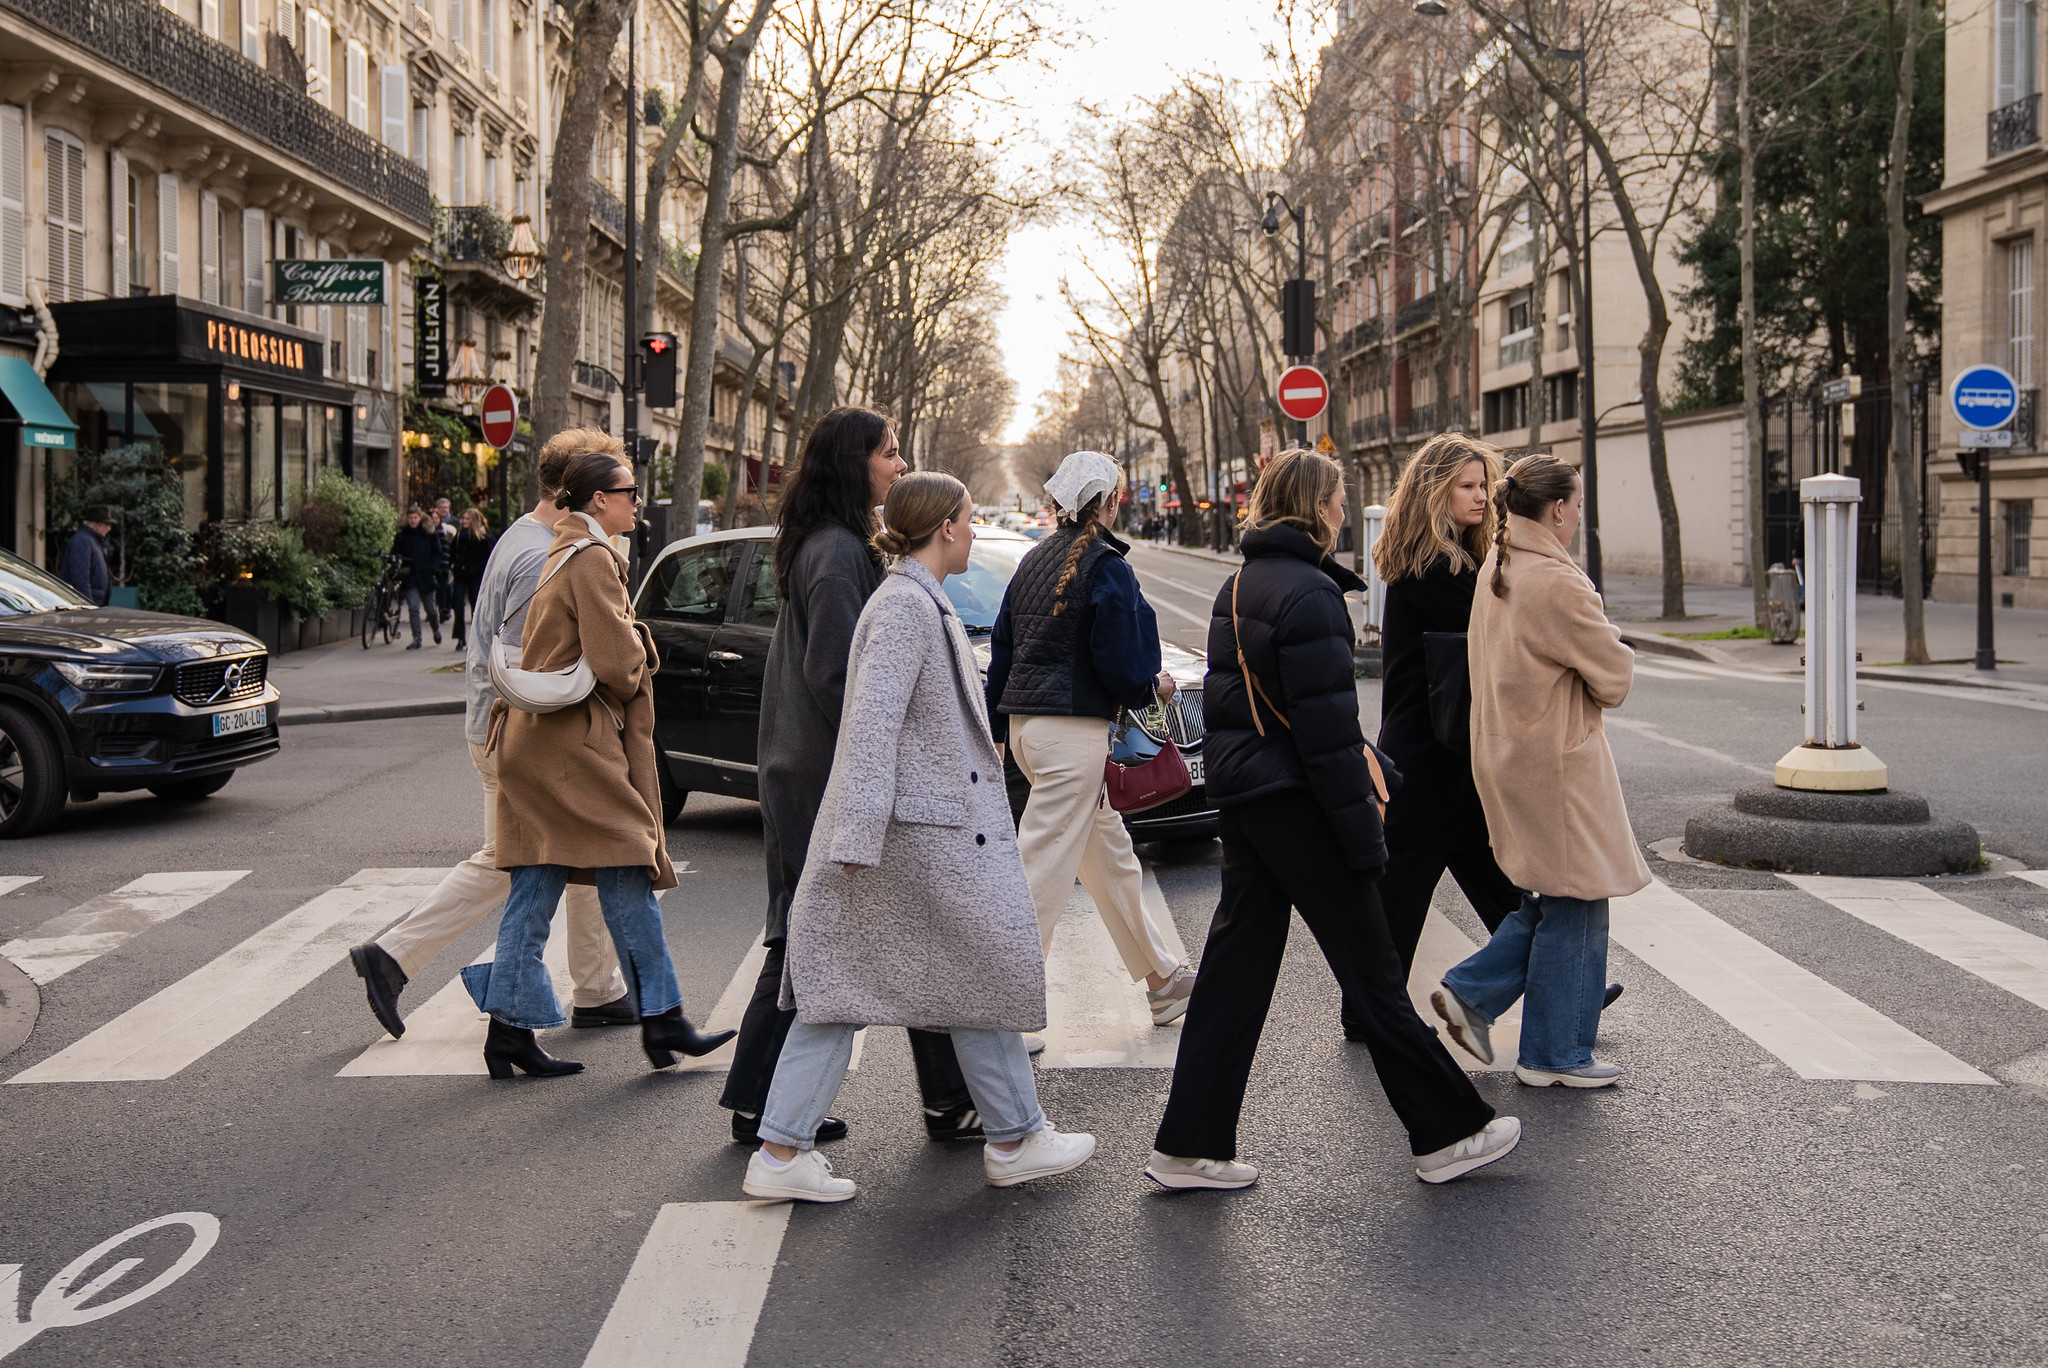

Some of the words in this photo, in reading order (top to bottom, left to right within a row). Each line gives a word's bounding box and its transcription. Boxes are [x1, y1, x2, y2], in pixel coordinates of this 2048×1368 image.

[281, 263, 380, 288] Coiffure
[284, 283, 378, 302] Beauté
[207, 319, 304, 370] PETROSSIAN
[425, 284, 440, 377] JULIAN
